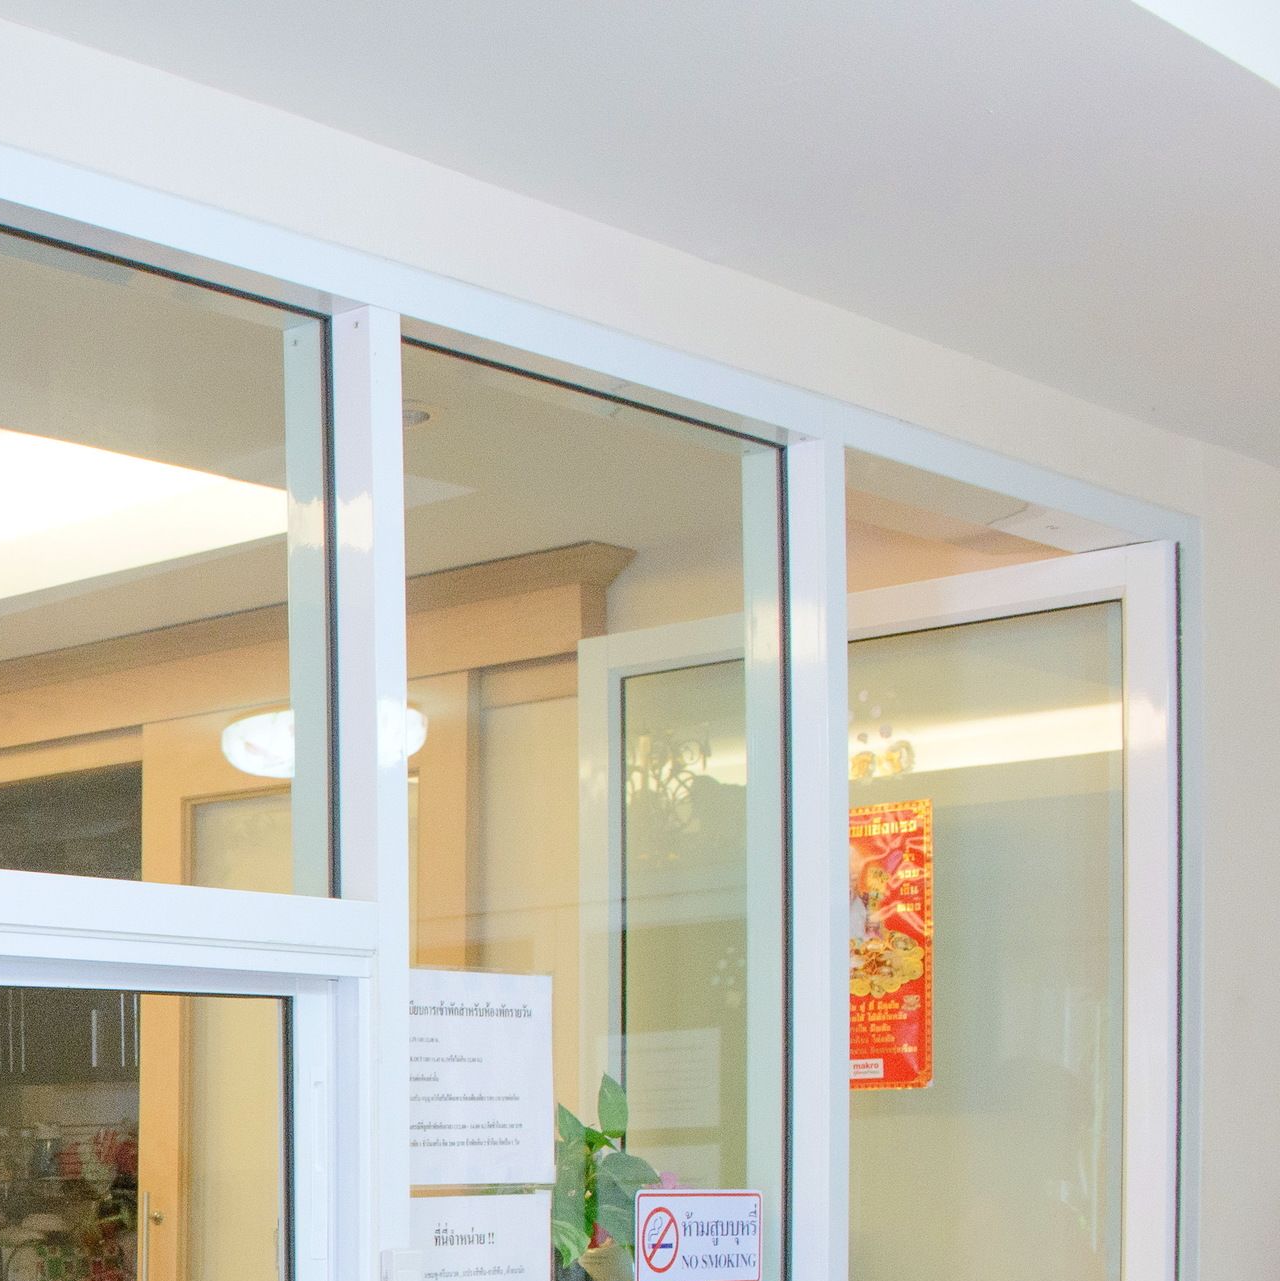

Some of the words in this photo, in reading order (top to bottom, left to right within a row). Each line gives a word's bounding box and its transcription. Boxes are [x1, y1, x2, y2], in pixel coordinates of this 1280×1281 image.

[681, 1204, 758, 1246] ห้ามสูบบุหรี่
[682, 1255, 699, 1270] NO
[701, 1253, 756, 1270] SMOKING
